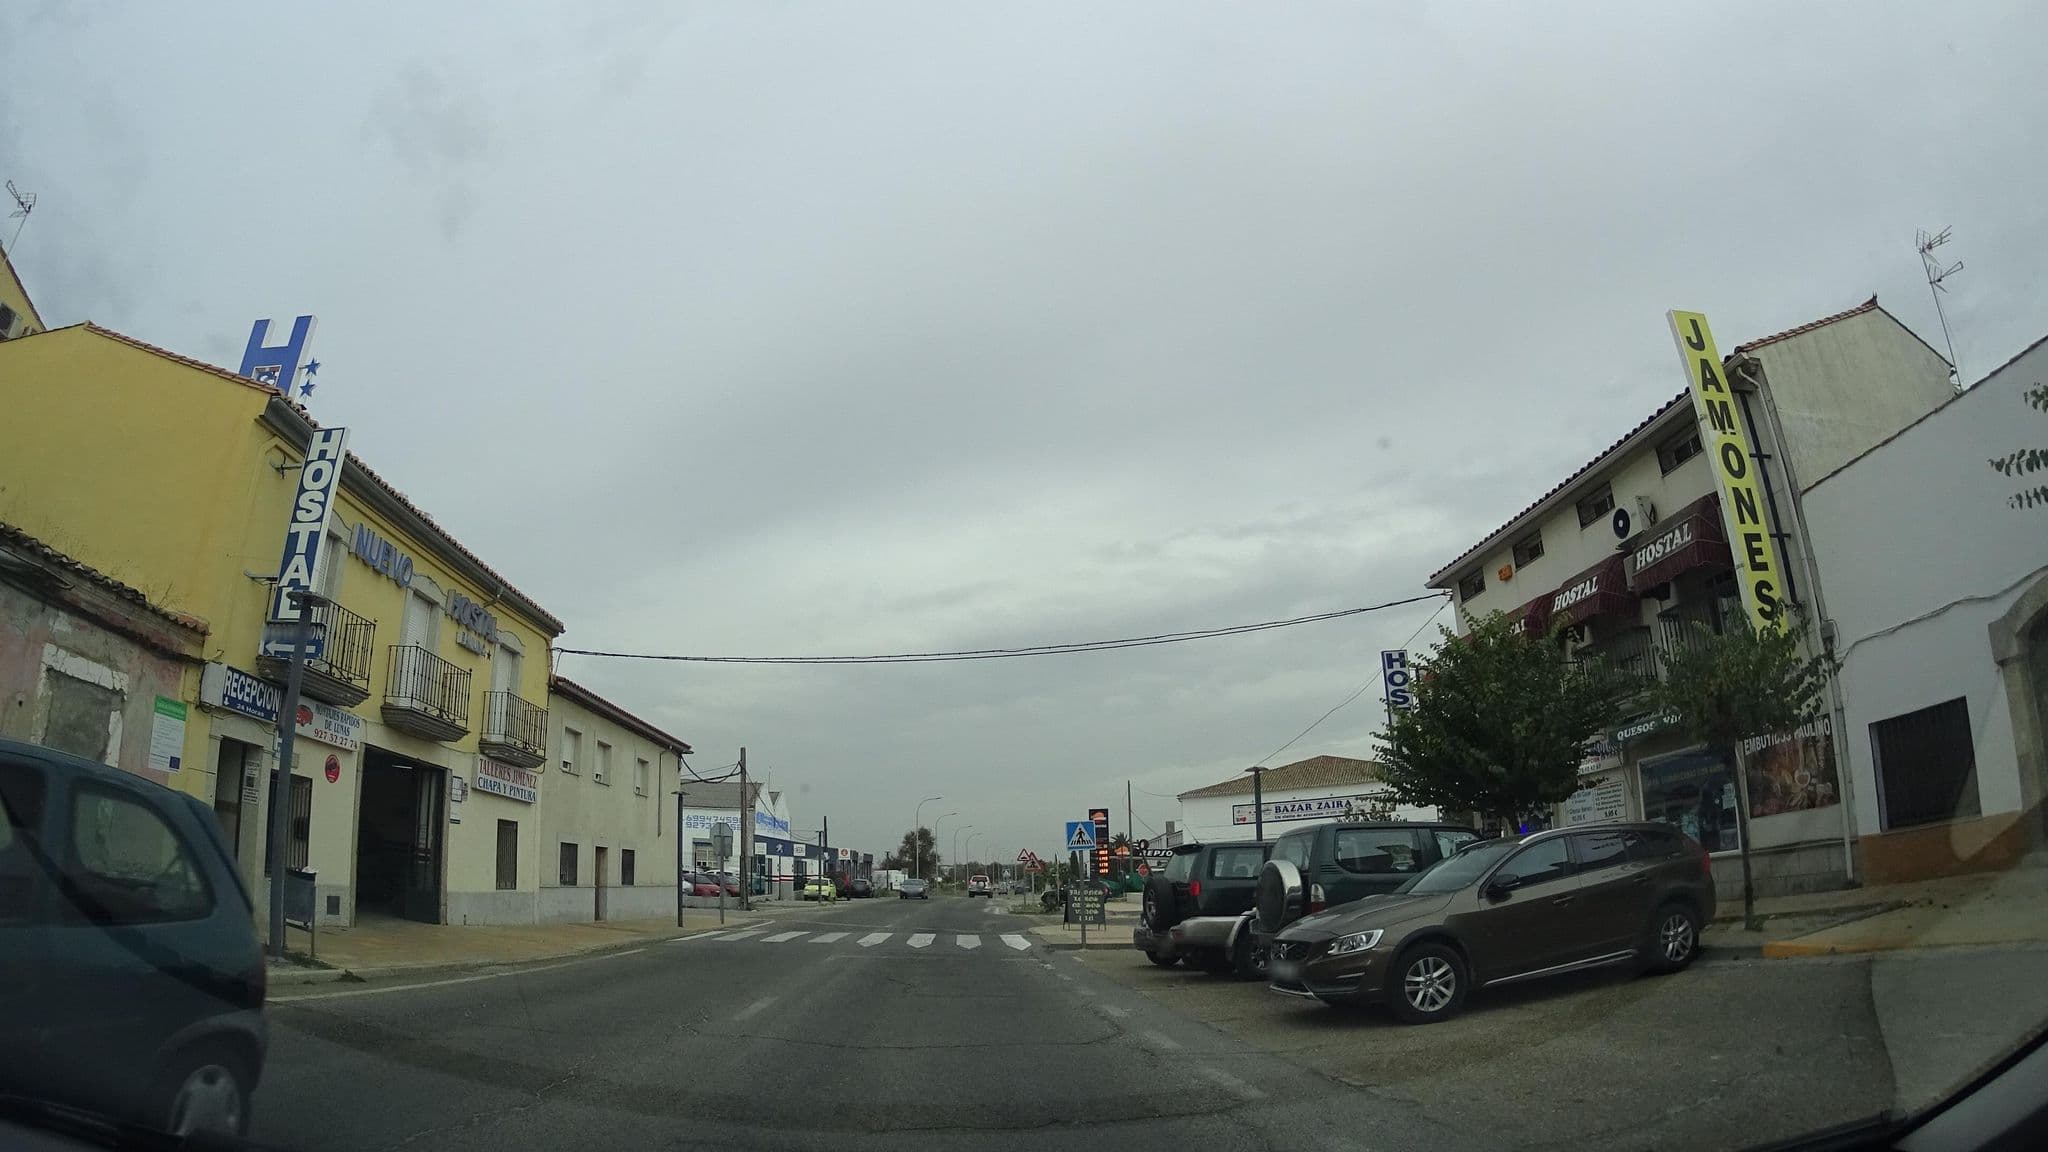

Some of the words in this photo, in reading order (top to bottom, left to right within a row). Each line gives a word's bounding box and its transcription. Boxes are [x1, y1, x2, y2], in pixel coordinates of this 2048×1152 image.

[1686, 319, 1779, 621] JAMONES
[278, 430, 343, 620] HOSTAL
[353, 523, 414, 588] NUEVO
[1635, 523, 1692, 570] HOSTAL
[1553, 576, 1599, 612] HOSTAL
[223, 670, 281, 713] RECEPCION
[314, 728, 327, 740] 927
[478, 777, 501, 793] CHAPA
[503, 783, 507, 794] Y
[1275, 804, 1312, 813] BAZAR
[1317, 800, 1352, 809] ZAIRA
[1140, 849, 1173, 857] REPSO
